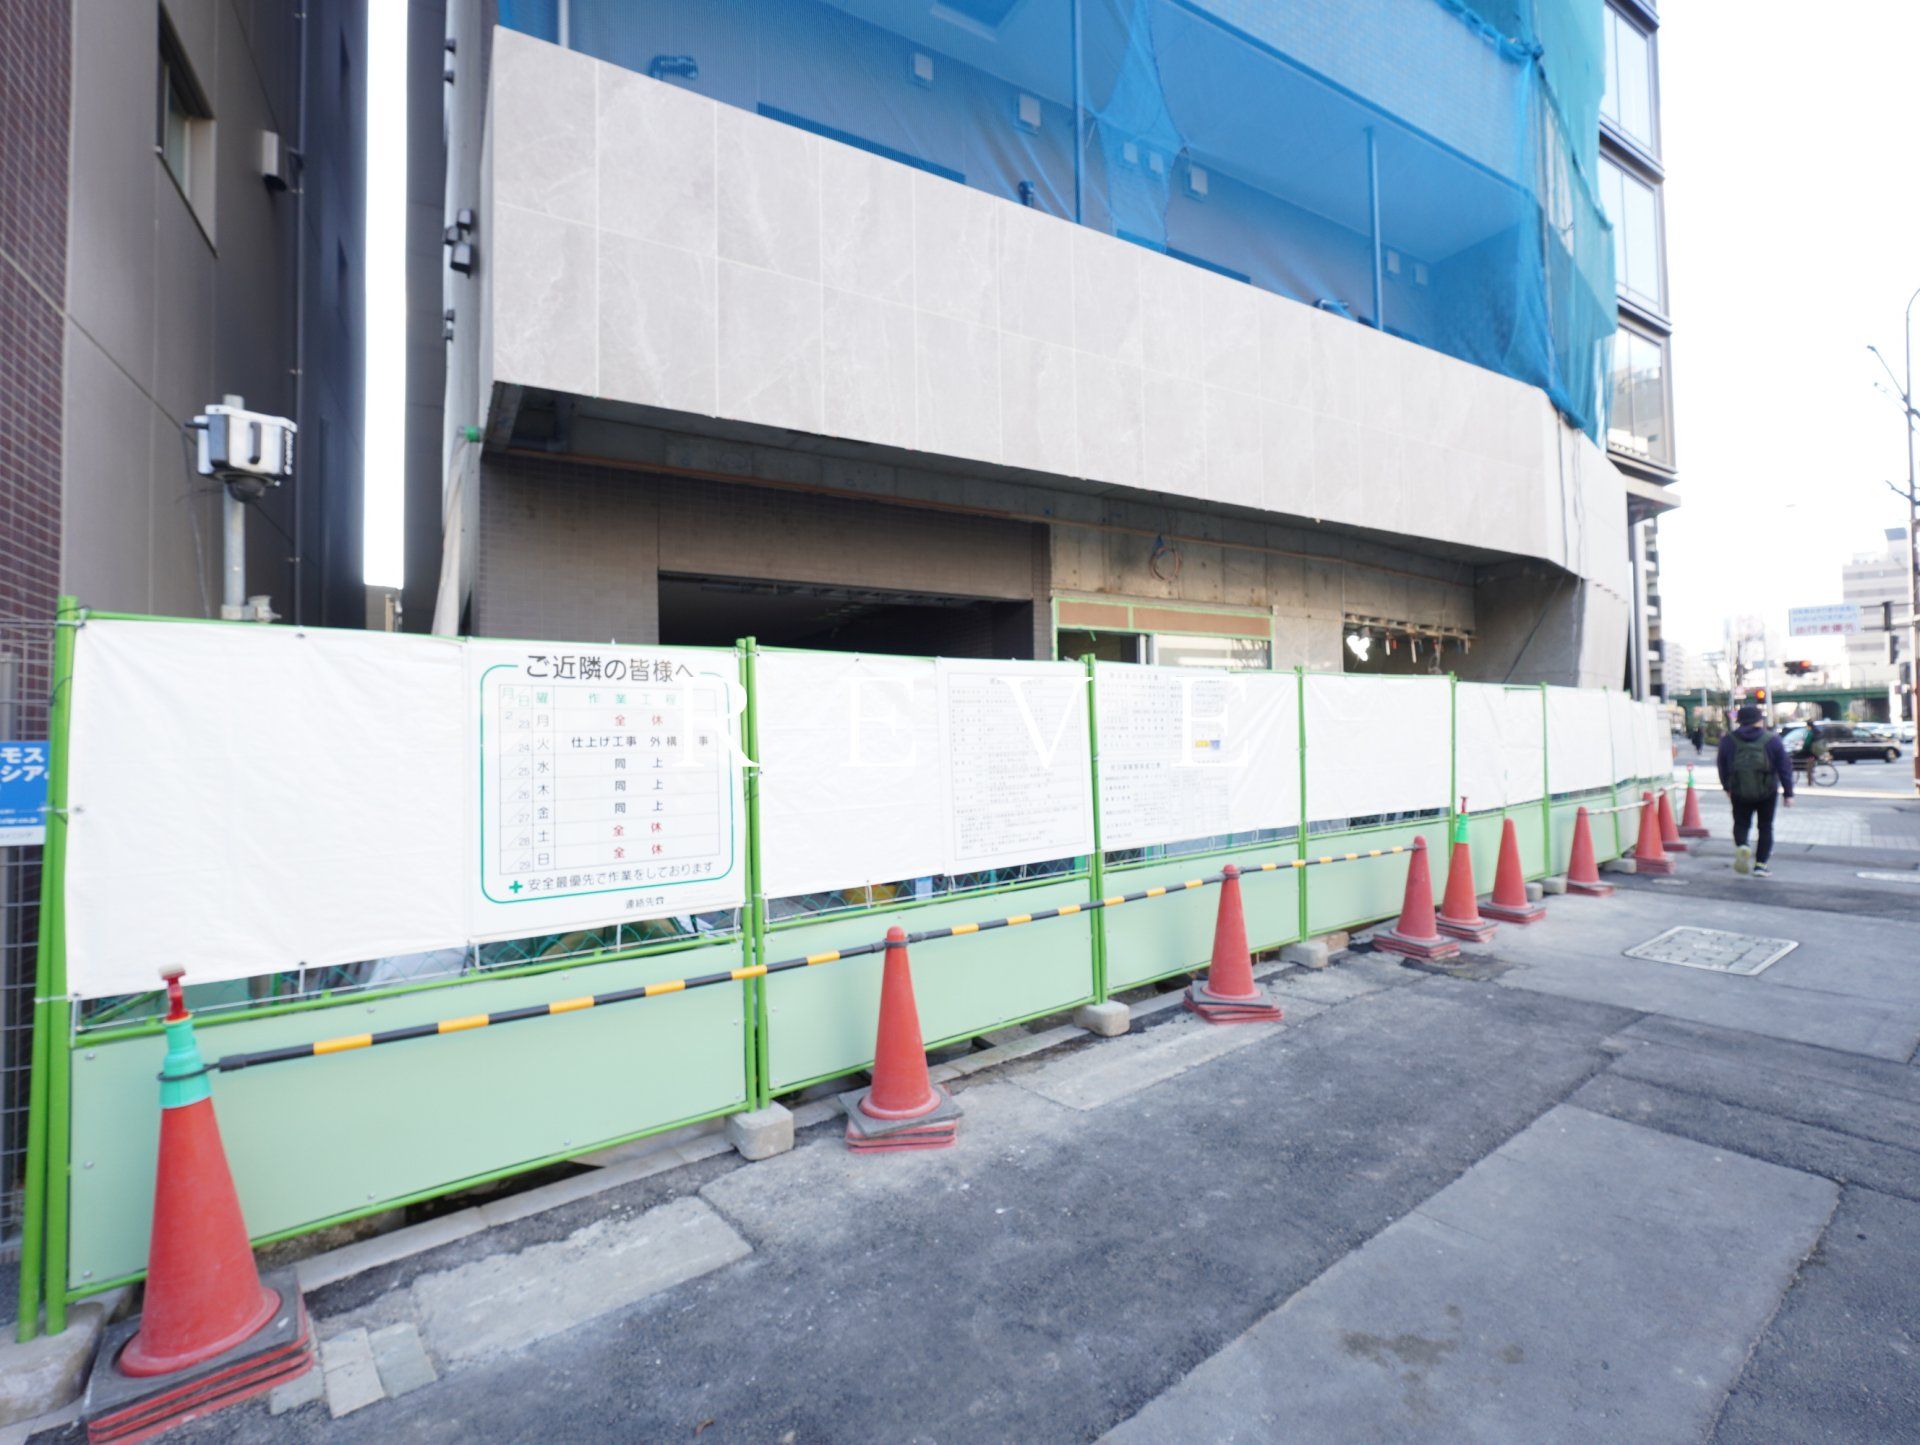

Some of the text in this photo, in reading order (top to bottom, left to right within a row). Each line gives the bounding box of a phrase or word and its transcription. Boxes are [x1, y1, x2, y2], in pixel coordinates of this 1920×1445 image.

[526, 655, 694, 683] ご近隣の皆様へ
[537, 714, 549, 728] 月
[537, 738, 549, 750] 火
[571, 735, 637, 748] 仕上げ工事
[650, 735, 708, 748] 外構事
[537, 761, 549, 774] 水
[537, 784, 550, 796] 木
[537, 806, 549, 819] 金
[537, 830, 550, 842] 土
[538, 853, 550, 866] 日
[528, 862, 713, 892] 安全最優先で作業をしております
